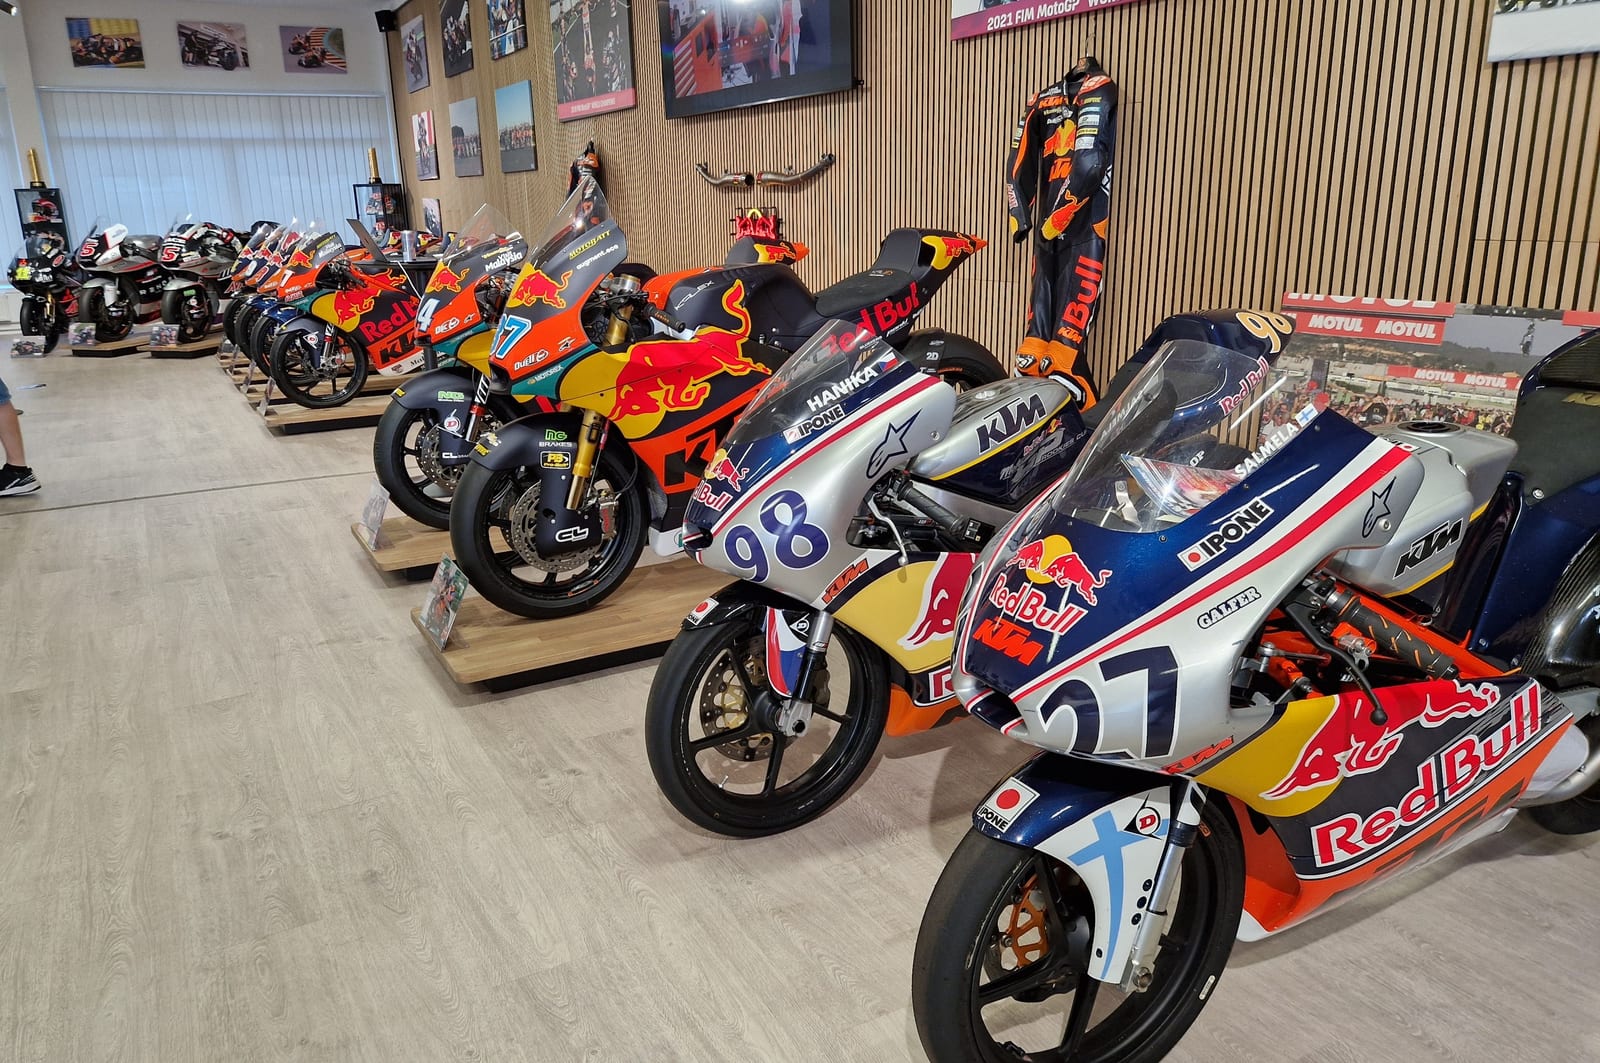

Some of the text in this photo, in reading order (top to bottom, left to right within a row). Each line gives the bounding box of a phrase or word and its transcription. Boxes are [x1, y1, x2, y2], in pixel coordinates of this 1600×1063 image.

[987, 12, 1013, 31] 2021
[1015, 8, 1035, 25] FIM
[1037, 0, 1080, 19] MotoGP
[79, 242, 99, 257] 5
[161, 246, 181, 262] 5
[485, 251, 523, 272] Malaysia
[1062, 256, 1104, 330] Bull
[360, 302, 408, 343] Red
[1057, 326, 1083, 344] KTM
[1308, 315, 1364, 333] MOTUL
[1375, 320, 1437, 339] MOTUL
[926, 351, 939, 361] 2D
[1414, 368, 1508, 389] MOTUL MOTUL
[806, 366, 879, 412] HANIKA
[1219, 356, 1269, 416] Red Bull
[797, 405, 845, 437] IPONE
[976, 393, 1048, 456] KTM
[1235, 422, 1300, 480] SALMELA
[697, 483, 734, 512] Bull
[723, 489, 830, 584] 98
[1200, 500, 1271, 557] IPONE
[1392, 517, 1464, 581] KTM
[821, 558, 869, 604] KTM
[988, 571, 1089, 636] Red Bull
[1197, 586, 1262, 630] GALFER
[972, 615, 1045, 667] KTM
[1035, 644, 1180, 760] 27
[1311, 755, 1440, 868] Red
[1440, 678, 1542, 803] Bull
[978, 805, 1010, 833] IPONE
